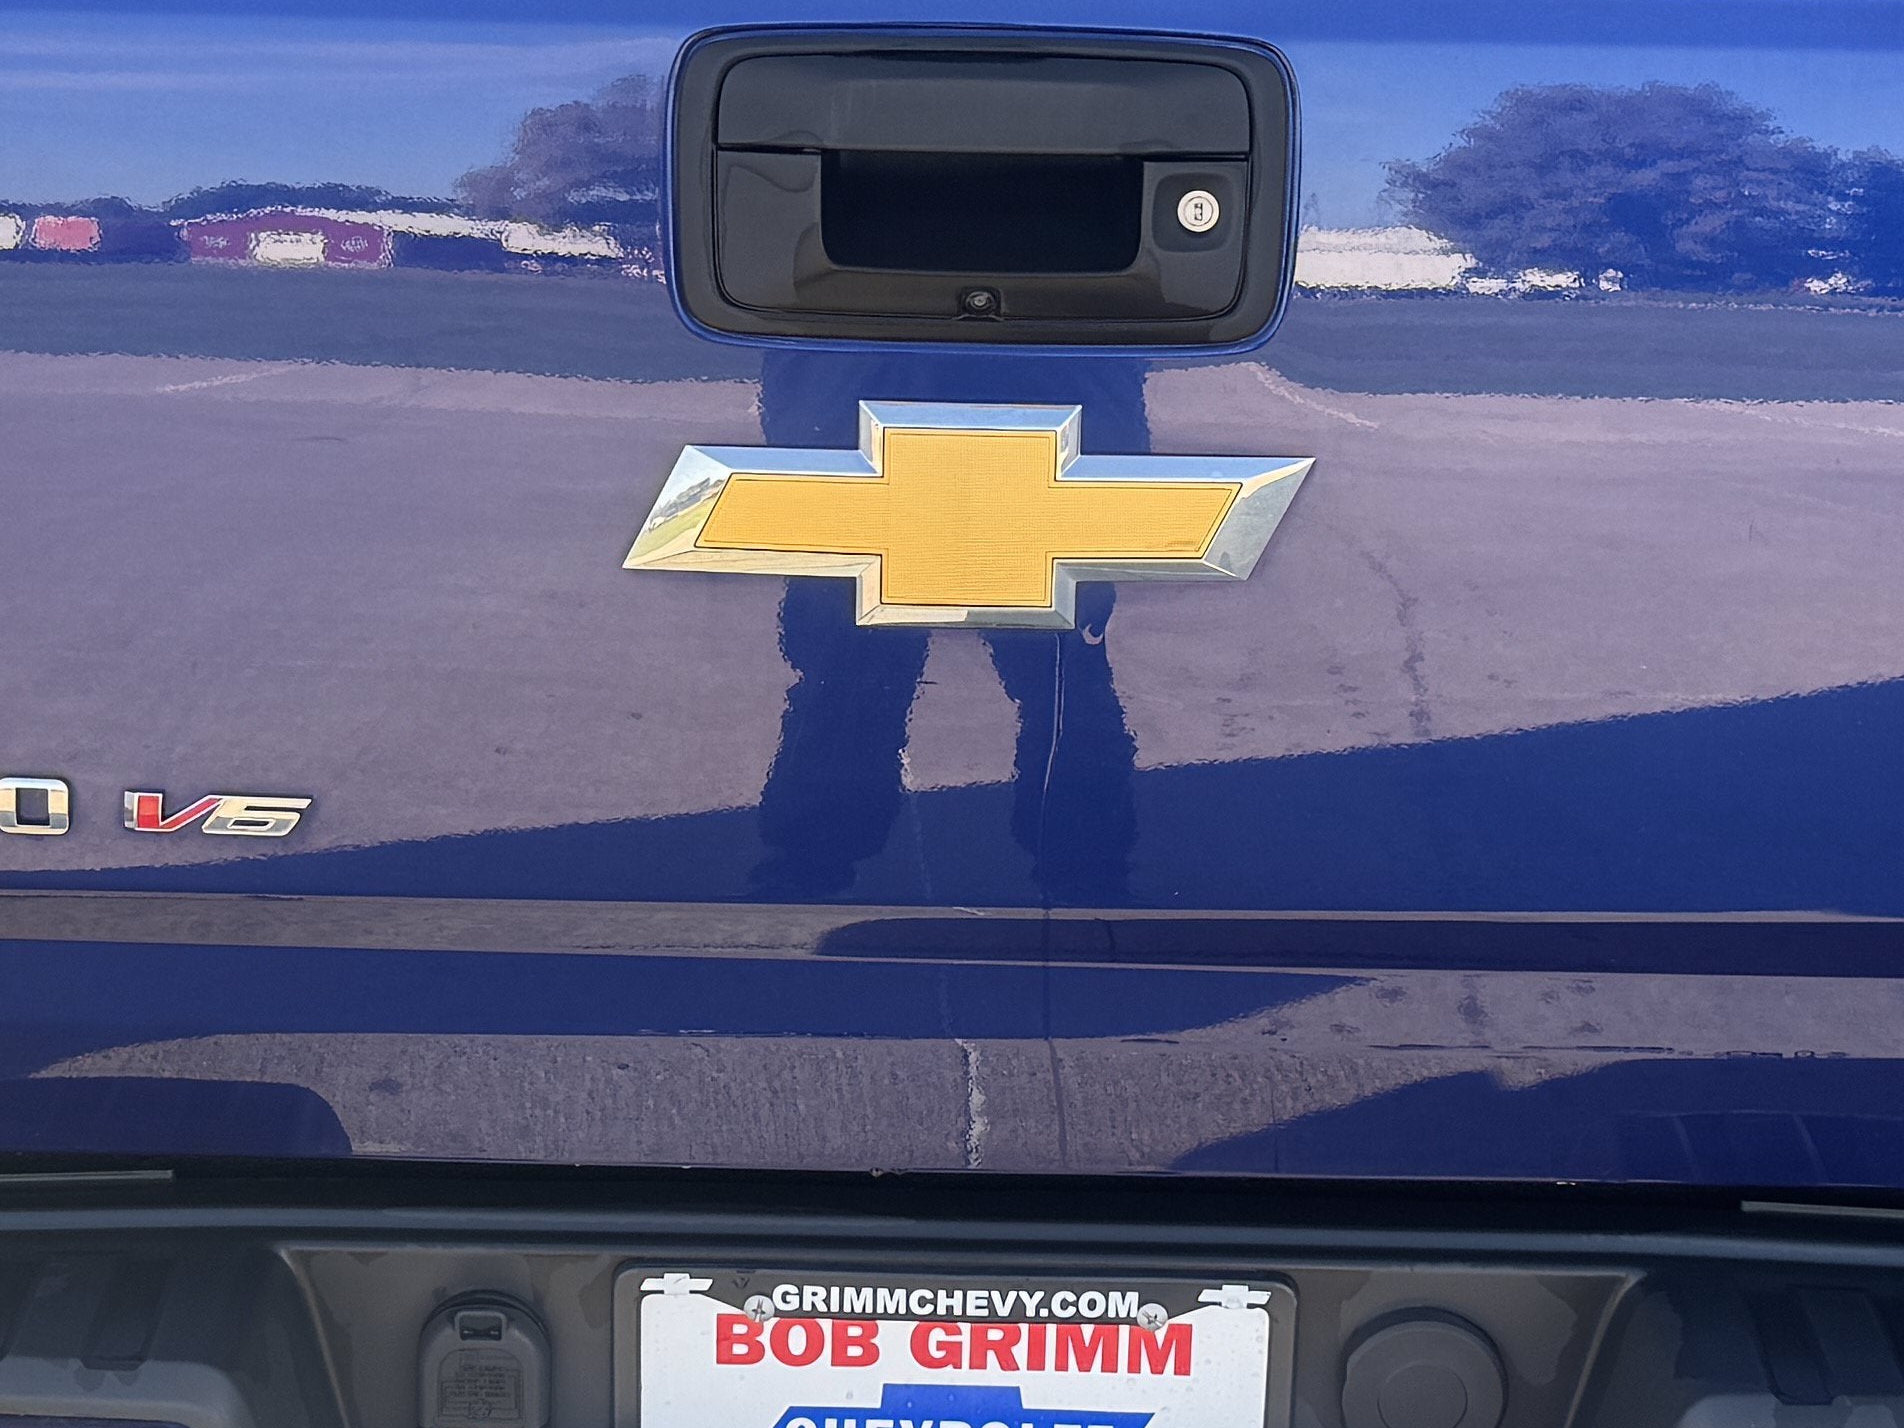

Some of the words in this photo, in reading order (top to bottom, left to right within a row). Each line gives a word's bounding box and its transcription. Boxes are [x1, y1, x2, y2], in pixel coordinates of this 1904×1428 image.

[124, 790, 313, 837] V6
[772, 1284, 1140, 1318] GRIMMCHEVY.COM
[716, 1314, 880, 1368] BOB
[910, 1322, 1193, 1376] GRIMM
